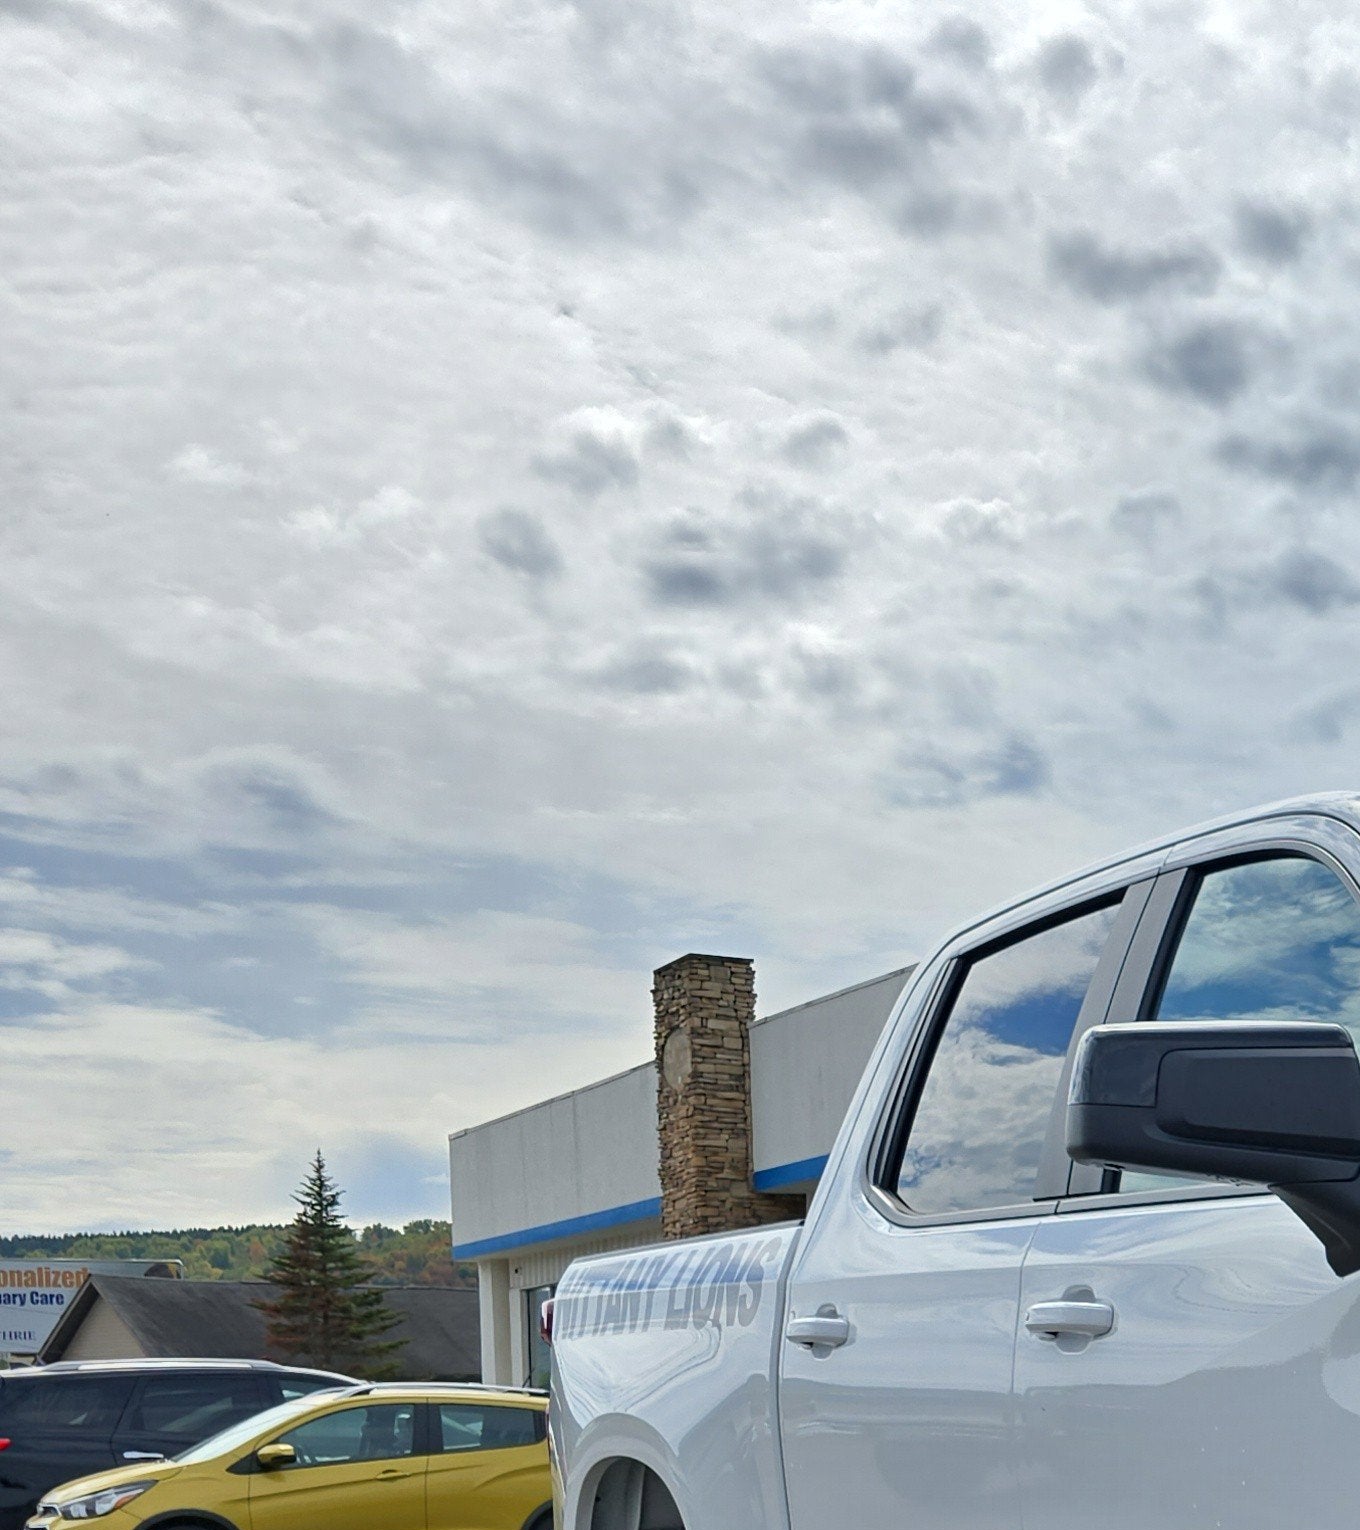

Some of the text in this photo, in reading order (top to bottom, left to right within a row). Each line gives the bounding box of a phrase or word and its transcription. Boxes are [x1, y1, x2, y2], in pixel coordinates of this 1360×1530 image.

[0, 1291, 64, 1307] ary Care
[663, 1236, 783, 1331] LIONS
